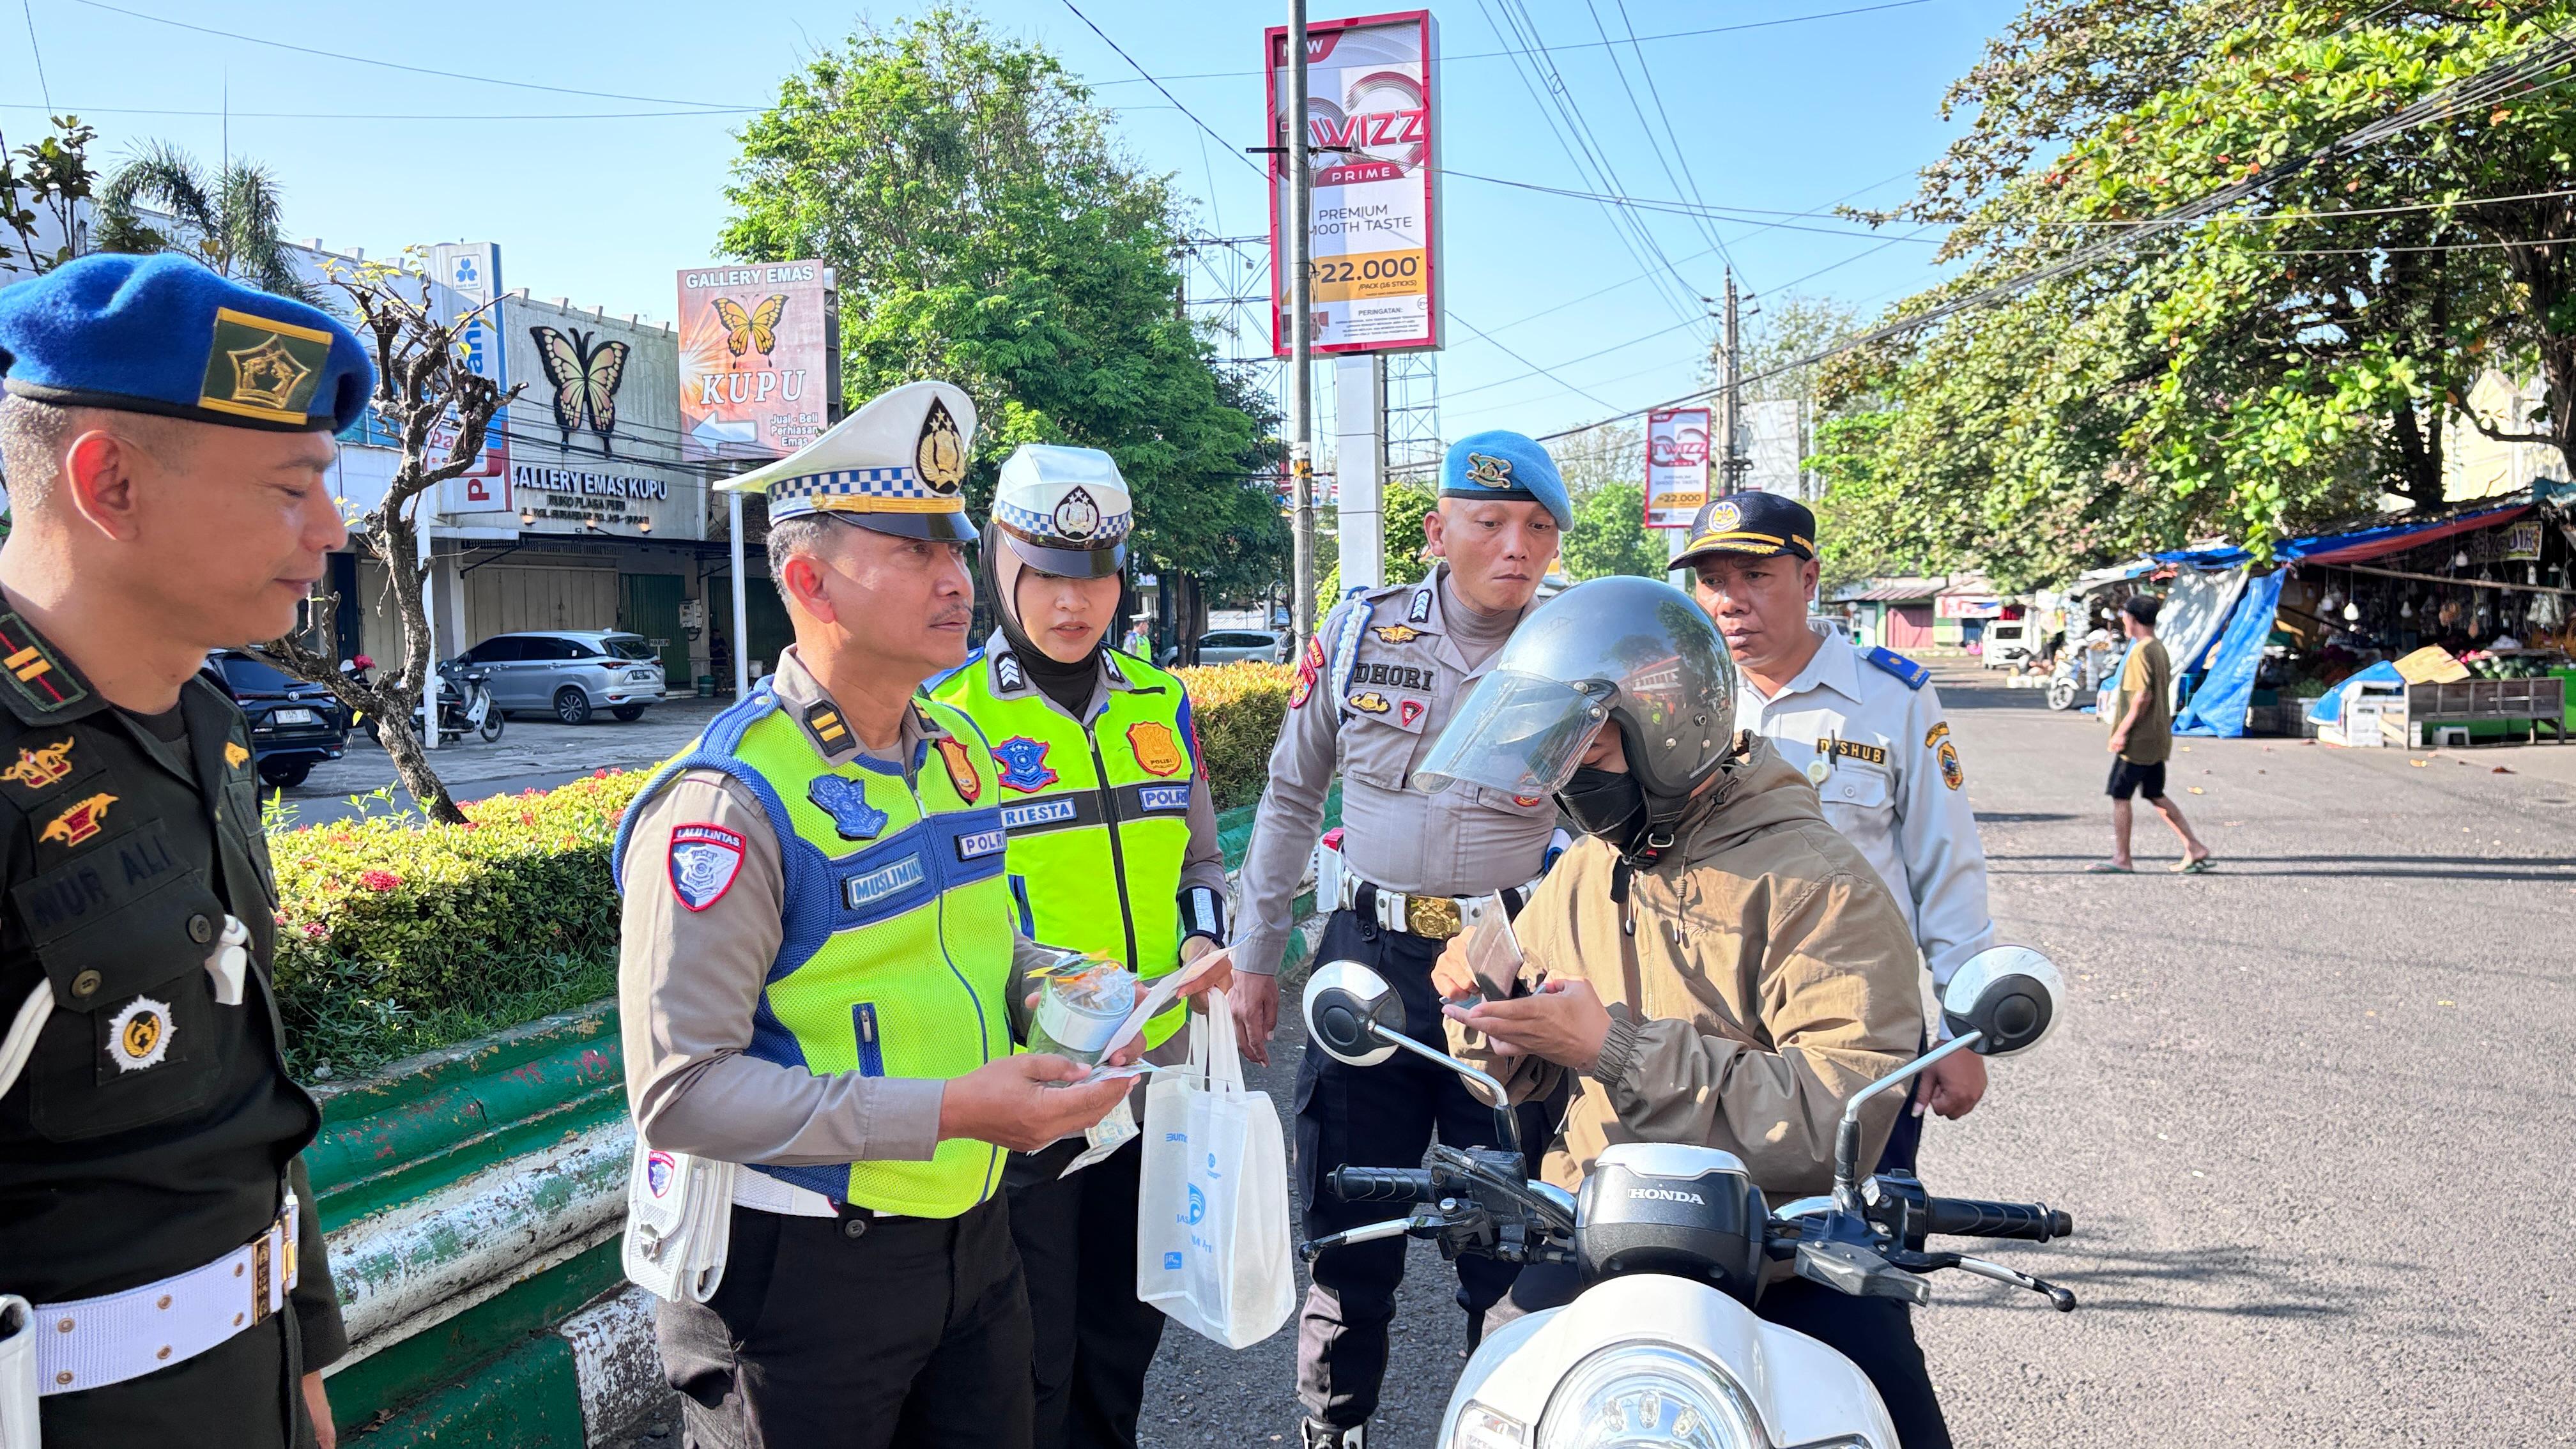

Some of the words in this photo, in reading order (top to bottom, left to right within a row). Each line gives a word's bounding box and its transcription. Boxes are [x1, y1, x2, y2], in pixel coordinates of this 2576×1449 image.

[1283, 40, 1323, 57] NW
[1282, 109, 1423, 148] WIZZ
[1331, 167, 1390, 182] PRIME
[1319, 204, 1388, 221] PREMIUM
[1309, 221, 1360, 236] MOOTH
[1364, 217, 1412, 231] TASTE
[686, 268, 762, 288] GALLERY
[767, 265, 815, 283] EMAS
[700, 369, 806, 405] KUPU
[770, 414, 791, 425] Jual
[770, 424, 818, 436] Perhiasan
[781, 436, 808, 447] Emas
[584, 473, 626, 496] EMAS
[629, 479, 668, 500] KUPU
[1354, 663, 1434, 691] DHORI
[1820, 740, 1882, 762] DSHUB
[1005, 803, 1070, 824] RIESTA
[34, 866, 110, 927] NUR
[119, 835, 172, 885] ALI
[855, 859, 923, 901] MUSLIMIN
[1628, 1188, 1706, 1205] HONDA
